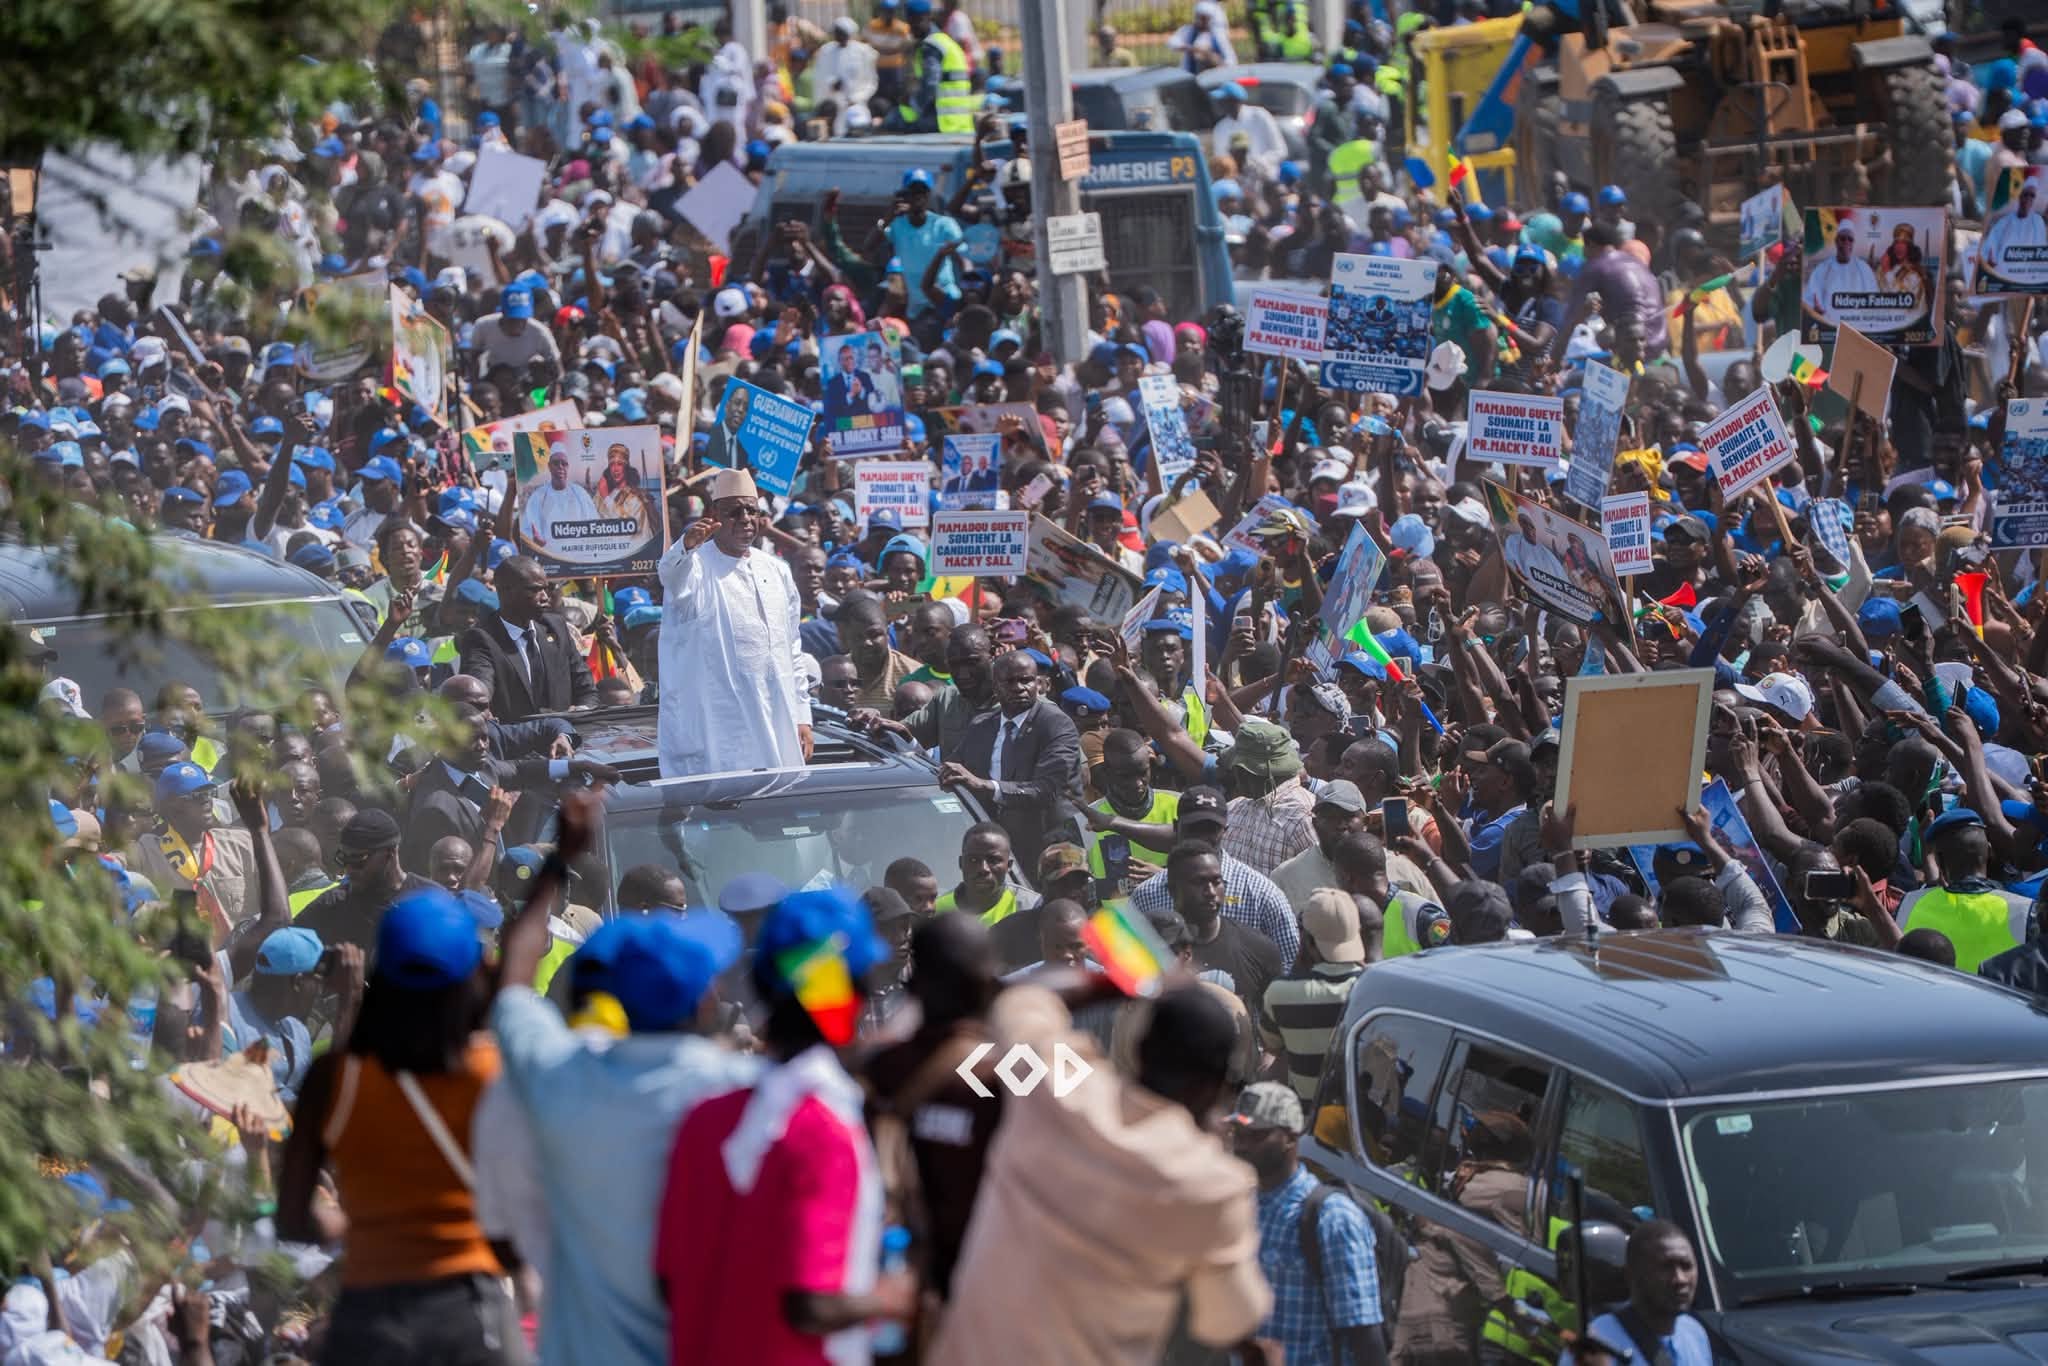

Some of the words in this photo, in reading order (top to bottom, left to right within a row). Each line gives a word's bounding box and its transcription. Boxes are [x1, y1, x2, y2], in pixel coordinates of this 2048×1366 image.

[1170, 156, 1196, 178] P3
[1254, 298, 1298, 314] MAMADOU
[1834, 294, 1866, 309] Ndeye
[1868, 295, 1897, 306] Fatou
[1899, 295, 1913, 306] LO
[1264, 310, 1304, 327] SOUHAITE
[1307, 318, 1317, 328] LA
[1260, 321, 1304, 337] BIENVENUE
[1307, 328, 1318, 340] AU
[1300, 339, 1324, 353] SALL
[1336, 352, 1408, 366] BIENVENUE
[1355, 380, 1386, 392] ONU
[1474, 402, 1526, 417] MAMADOU
[1528, 407, 1562, 421] GUEYE
[1487, 416, 1535, 431] SOUHAITE
[1538, 422, 1550, 432] LA
[1703, 416, 1744, 452] MAMADOU
[1743, 399, 1771, 425] GUEYE
[1483, 427, 1535, 442] BIENVENUE
[1538, 433, 1552, 444] AU
[1717, 426, 1758, 458] SOUHAITE
[1755, 418, 1768, 433] LA
[1472, 438, 1529, 455] PR.MACKY
[1531, 445, 1559, 458] SALL
[1720, 437, 1763, 472] BIENVENUE
[1762, 429, 1776, 445] AU
[1718, 452, 1764, 490] PR.MACKY
[1763, 439, 1788, 461] SALL
[860, 471, 900, 483] MAMADOU
[870, 483, 905, 493] SOUHAITE
[908, 483, 917, 493] LA
[868, 494, 905, 504] BIENVENUE
[904, 506, 924, 516] SALL
[1604, 507, 1630, 523] MAMADOU
[1630, 504, 1648, 518] GUEYE
[554, 524, 588, 538] Ndeye
[590, 522, 620, 535] Fatou
[621, 521, 636, 533] LO
[937, 523, 988, 534] MAMADOU
[991, 521, 1024, 532] GUEYE
[1611, 521, 1635, 535] SOUHAITE
[1636, 519, 1643, 532] LA
[948, 534, 997, 544] SOUTIENT
[1001, 533, 1012, 544] LA
[1609, 535, 1636, 550] BIENVENUE
[1636, 533, 1645, 546] AU
[561, 544, 584, 552] MAIRIE
[585, 543, 617, 551] RUFISQUE
[618, 542, 631, 550] EST
[937, 544, 1007, 556] CANDIDATURE
[1010, 544, 1022, 555] DE
[1634, 547, 1650, 561] SALL
[631, 560, 654, 571] 2027
[945, 556, 983, 568] MACKY
[985, 555, 1013, 567] SALL
